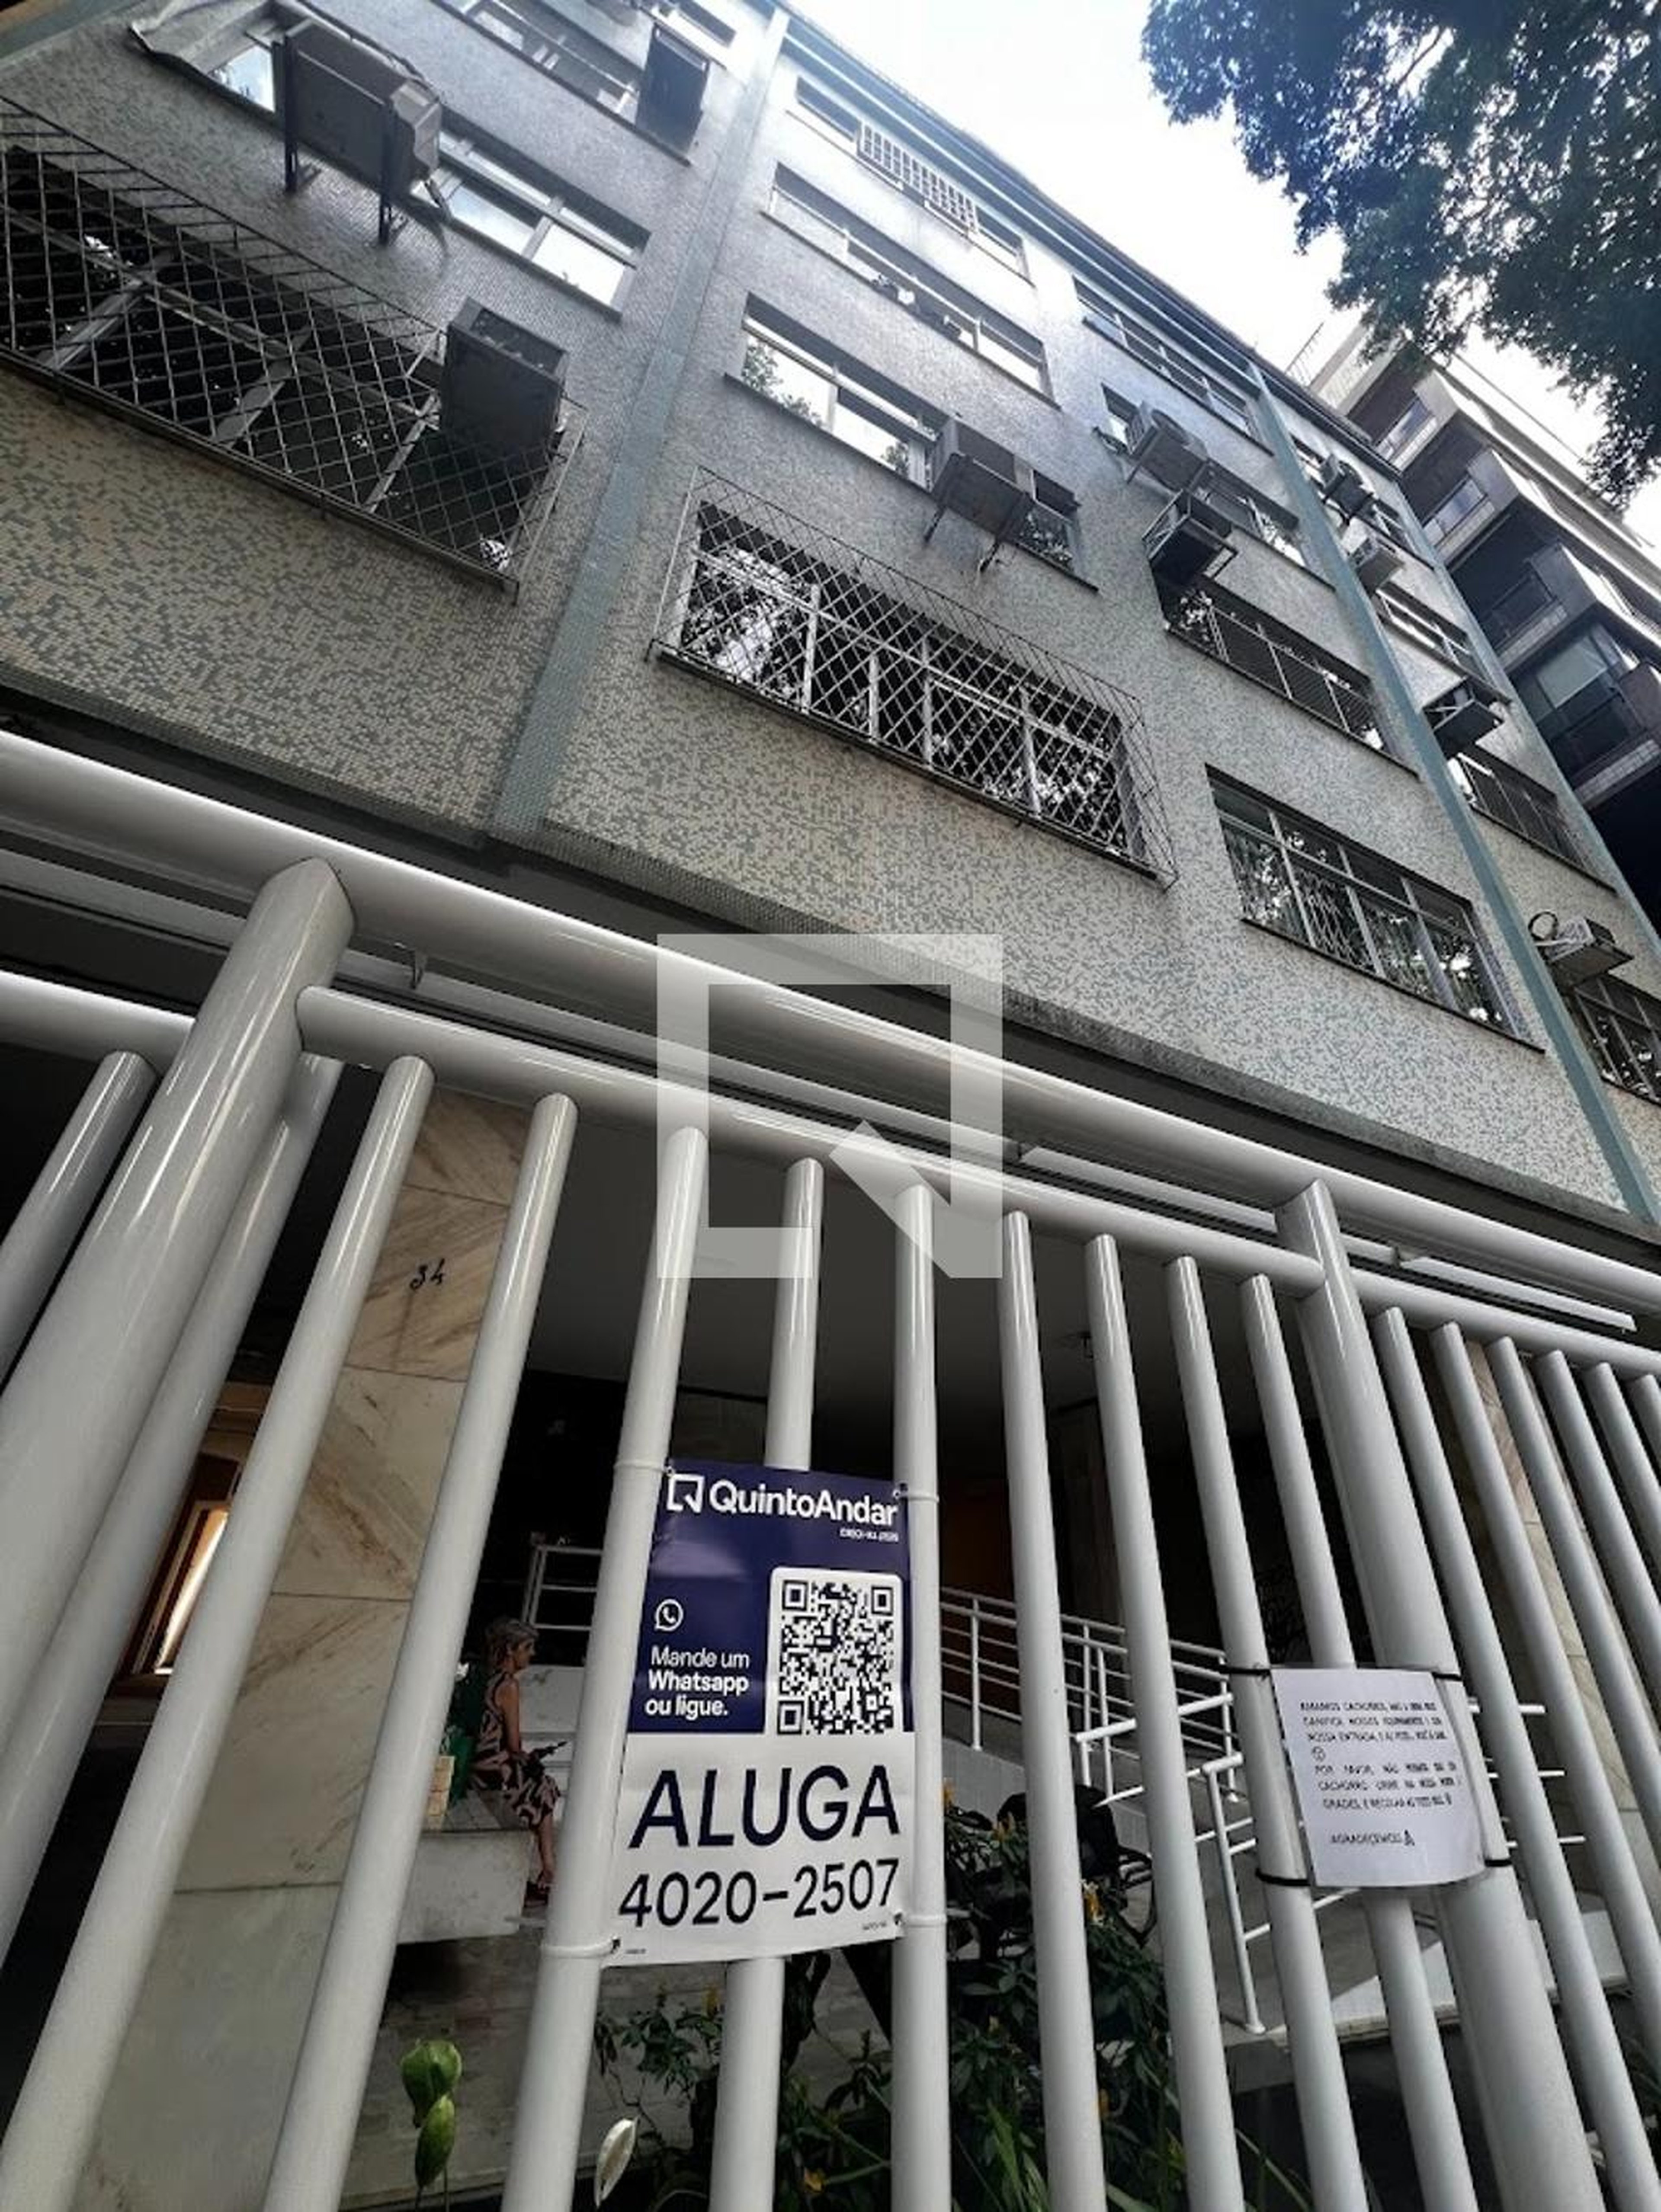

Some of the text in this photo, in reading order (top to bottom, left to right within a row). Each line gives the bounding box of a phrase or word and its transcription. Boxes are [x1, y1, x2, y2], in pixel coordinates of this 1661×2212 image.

[709, 1479, 898, 1527] QuintoAndar
[651, 1645, 750, 1668] Mande um
[648, 1668, 749, 1697] Whatsapp
[645, 1694, 728, 1721] ou ligue.
[628, 1765, 900, 1848] ALUGA
[619, 1859, 899, 1928] 4020-2507
